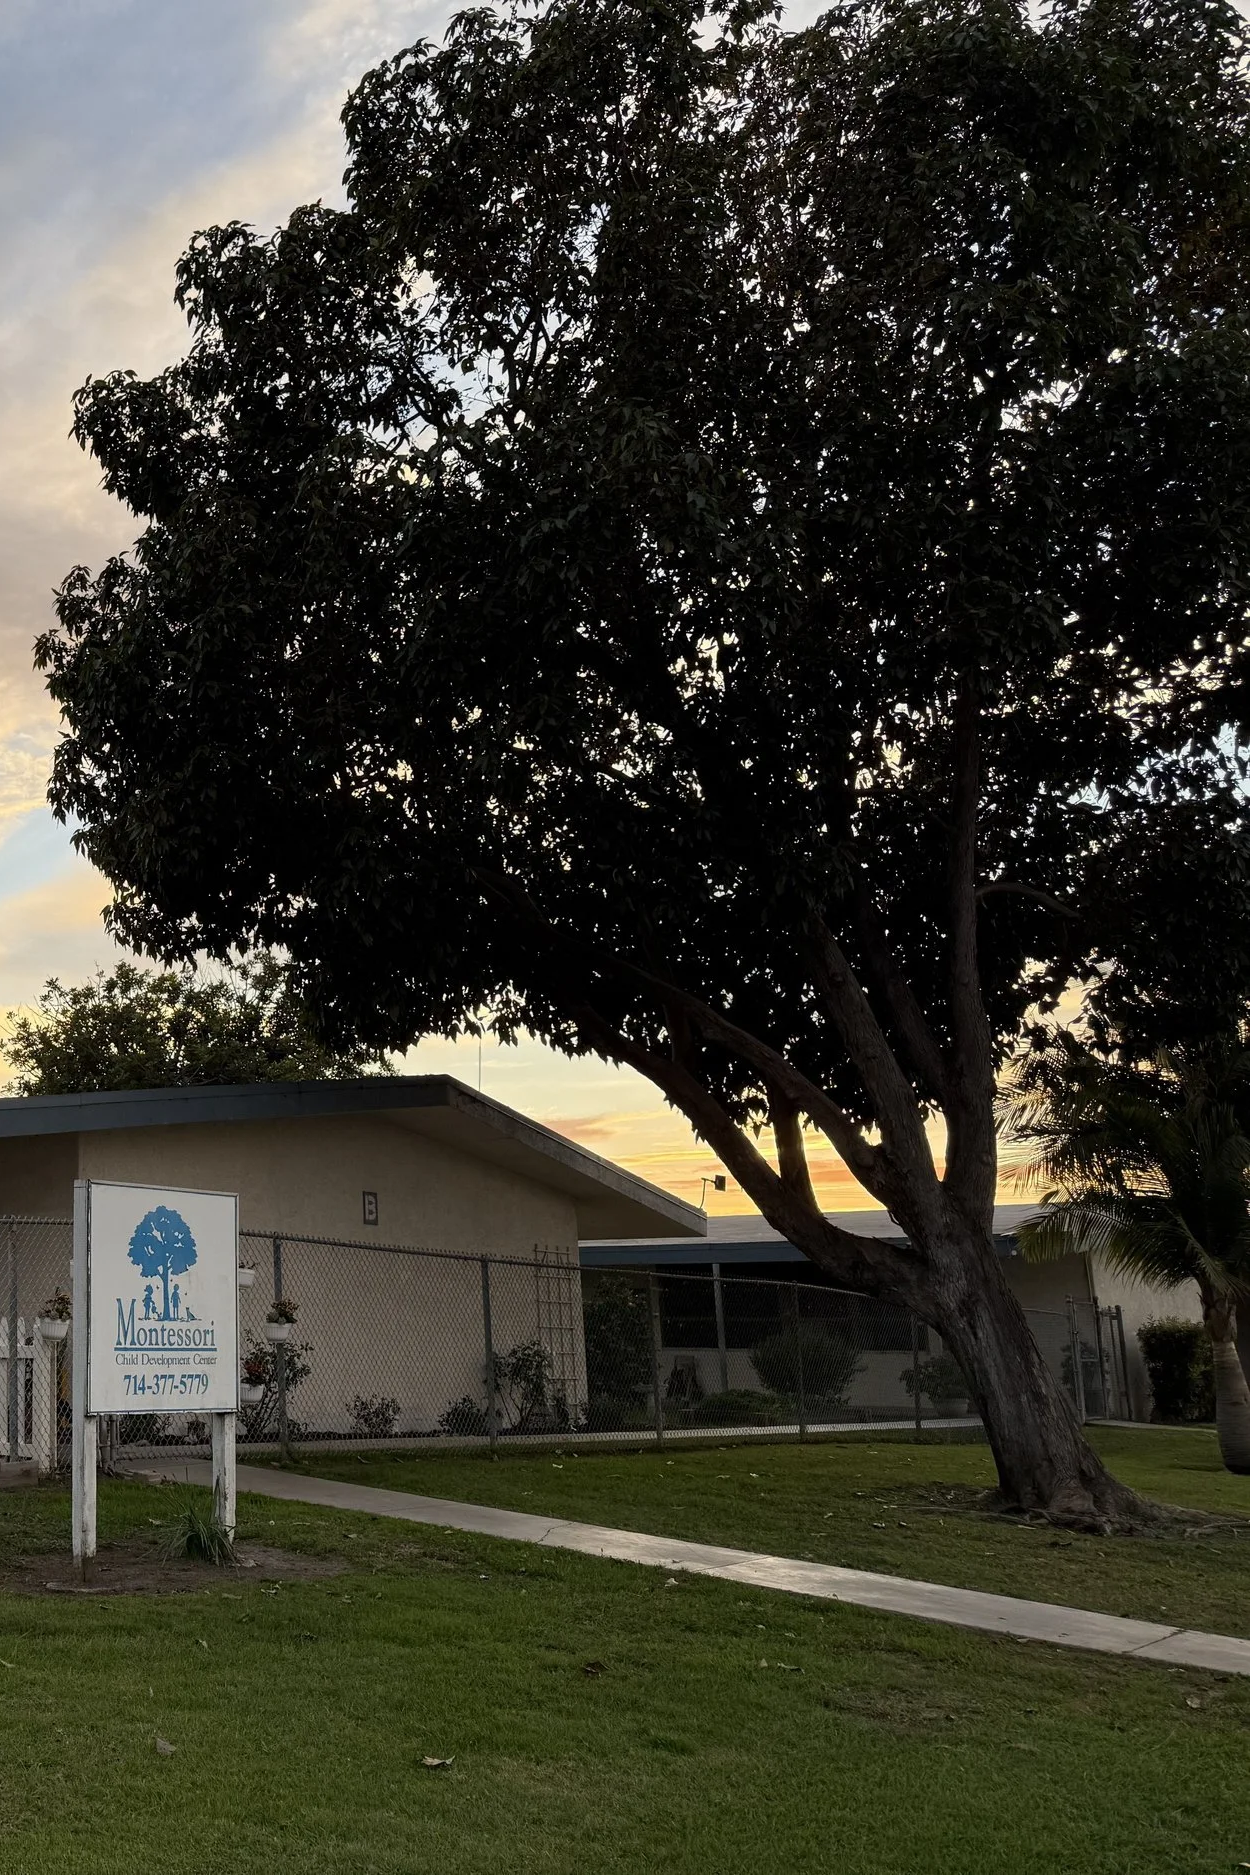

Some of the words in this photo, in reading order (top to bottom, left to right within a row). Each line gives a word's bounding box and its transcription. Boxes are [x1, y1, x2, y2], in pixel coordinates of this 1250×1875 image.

[365, 1194, 376, 1220] B
[116, 1298, 216, 1346] Montessori
[116, 1353, 138, 1366] Child
[141, 1353, 191, 1368] Development
[193, 1353, 217, 1365] Center
[123, 1373, 209, 1395] 714-377-5779
